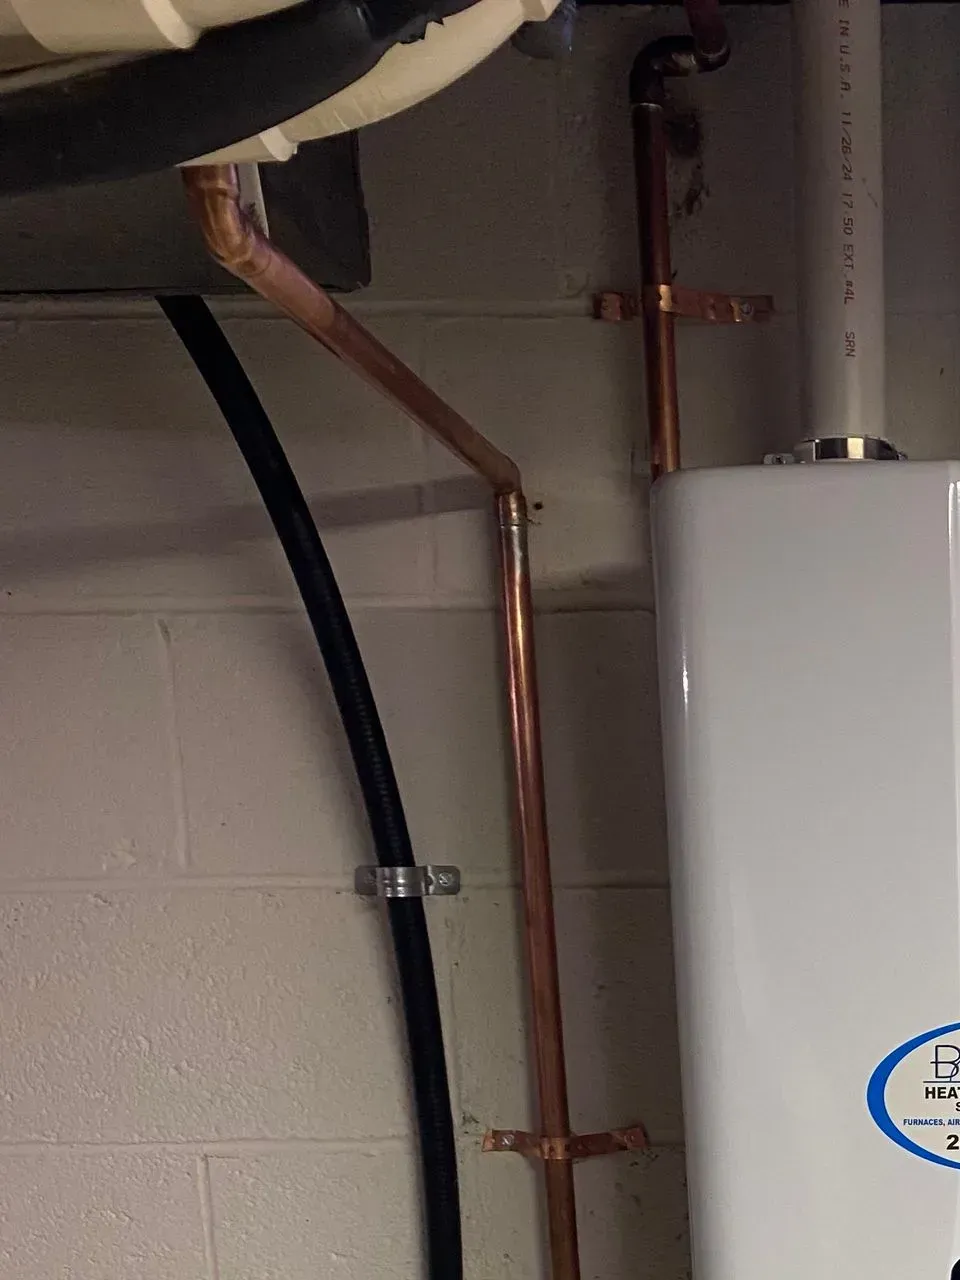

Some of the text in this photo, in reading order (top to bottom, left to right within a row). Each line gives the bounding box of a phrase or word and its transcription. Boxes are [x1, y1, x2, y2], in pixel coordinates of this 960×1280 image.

[839, 19, 850, 36] IN
[845, 332, 856, 357] SRN
[903, 1118, 945, 1126] FURNACES,
